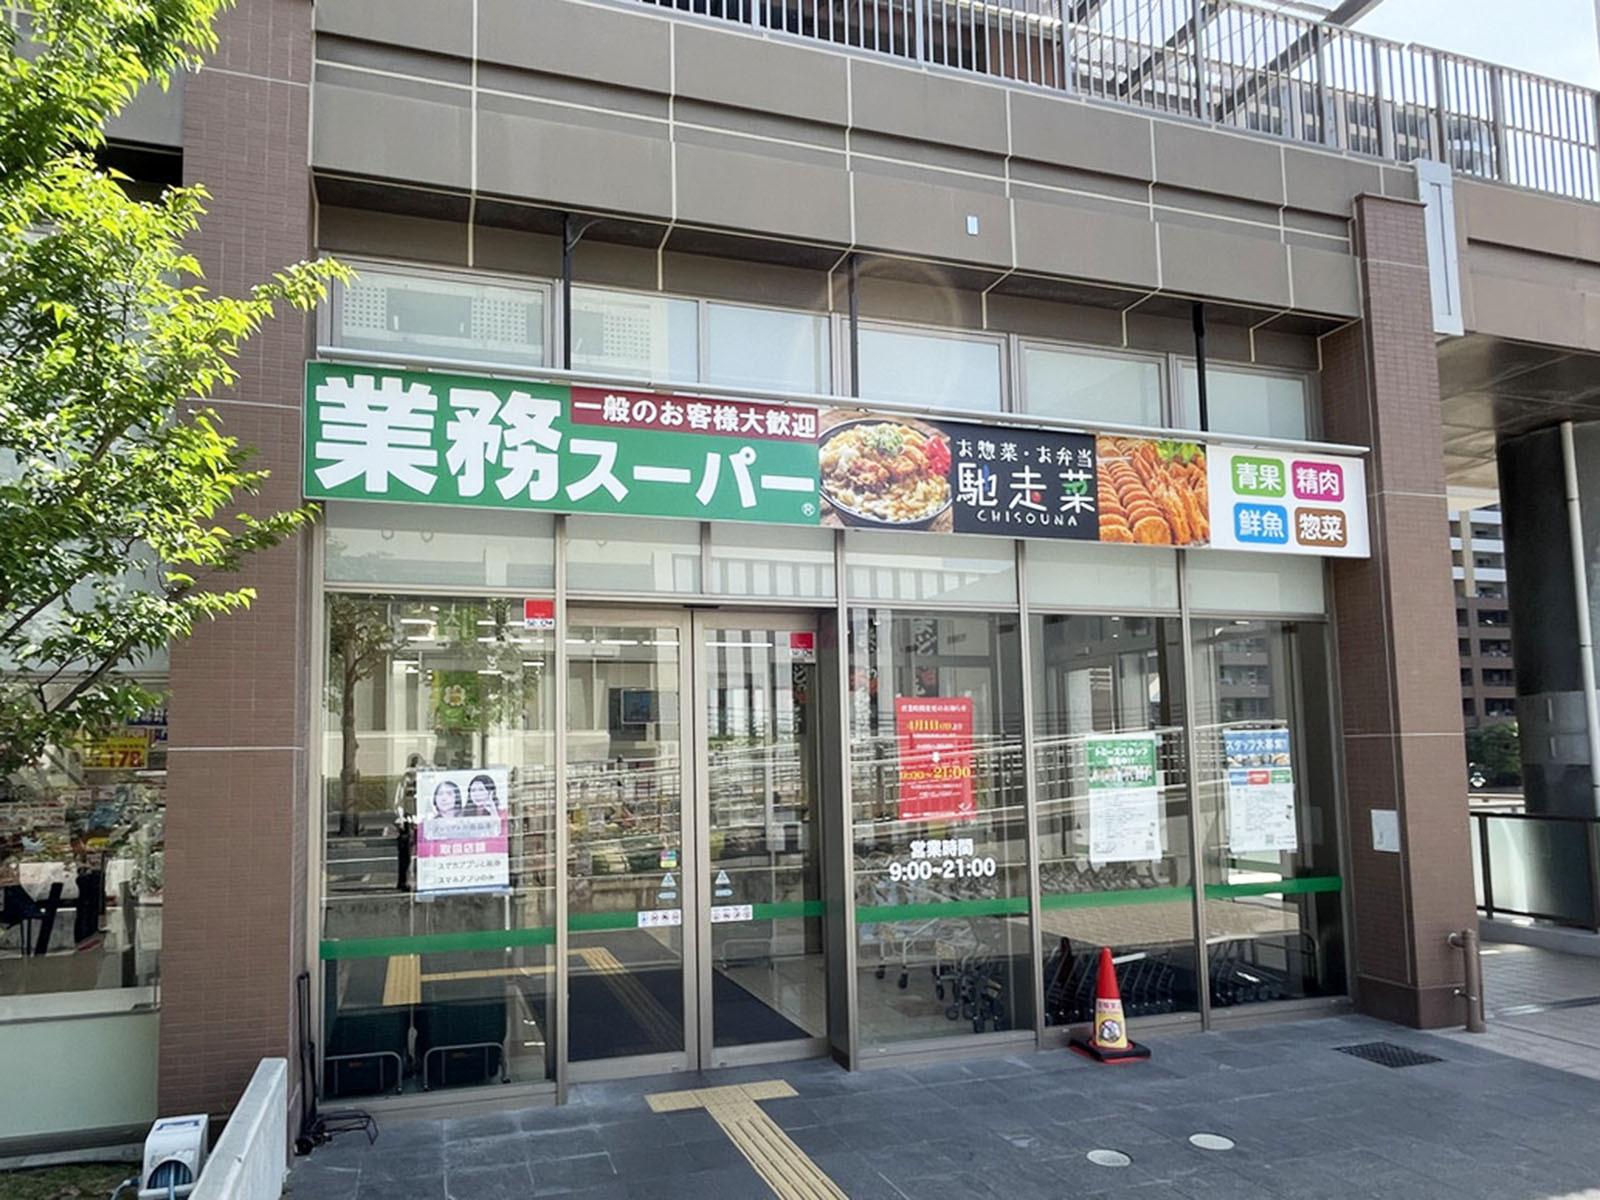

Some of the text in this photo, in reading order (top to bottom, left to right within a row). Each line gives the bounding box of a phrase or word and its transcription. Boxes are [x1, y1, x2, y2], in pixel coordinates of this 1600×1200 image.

[573, 394, 817, 438] 一般のお客様大歓迎
[313, 374, 815, 508] 業務スーパー
[956, 439, 1092, 468] お惣菜・お弁当
[1236, 463, 1282, 490] 青果
[1295, 467, 1340, 496] 精肉
[976, 509, 1078, 526] CHISOUNA
[1238, 509, 1285, 538] 鮮魚
[1299, 514, 1343, 541] 惣菜
[910, 839, 973, 858] 営業時間
